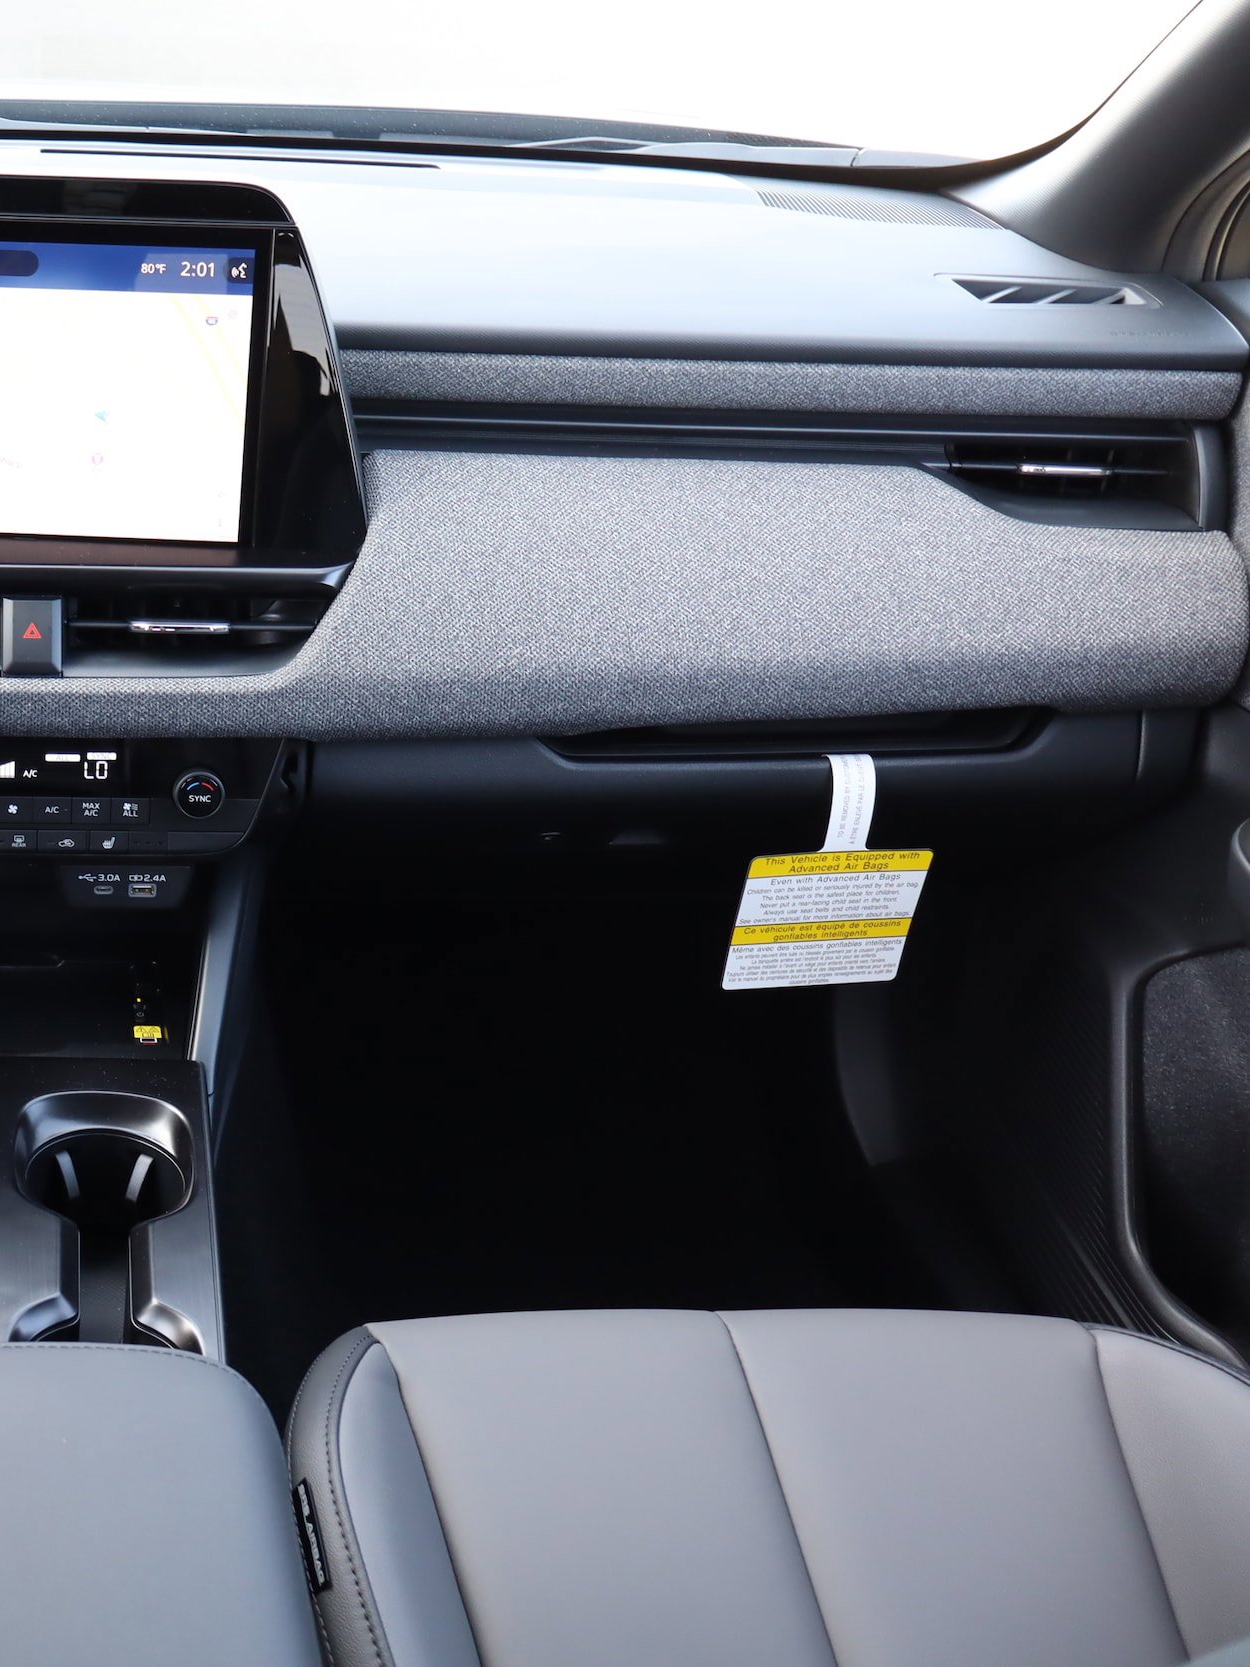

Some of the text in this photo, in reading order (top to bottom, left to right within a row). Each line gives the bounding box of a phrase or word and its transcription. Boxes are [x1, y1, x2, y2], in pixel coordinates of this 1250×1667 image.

[140, 263, 167, 274] 80°F
[180, 261, 215, 278] 2:01
[22, 770, 38, 778] A/C
[84, 761, 108, 780] LO
[44, 806, 60, 814] A/C
[765, 858, 786, 866] This
[791, 855, 828, 864] Vehicle
[846, 852, 895, 862] Equipped
[789, 862, 889, 873] Advanced Air Bags
[98, 874, 120, 882] 3.0A
[144, 874, 166, 882] 2.4A
[816, 874, 860, 883] Advanced
[878, 874, 902, 882] Bags
[864, 920, 902, 928] coussins
[822, 930, 868, 938] intelligents
[792, 942, 824, 950] coussins
